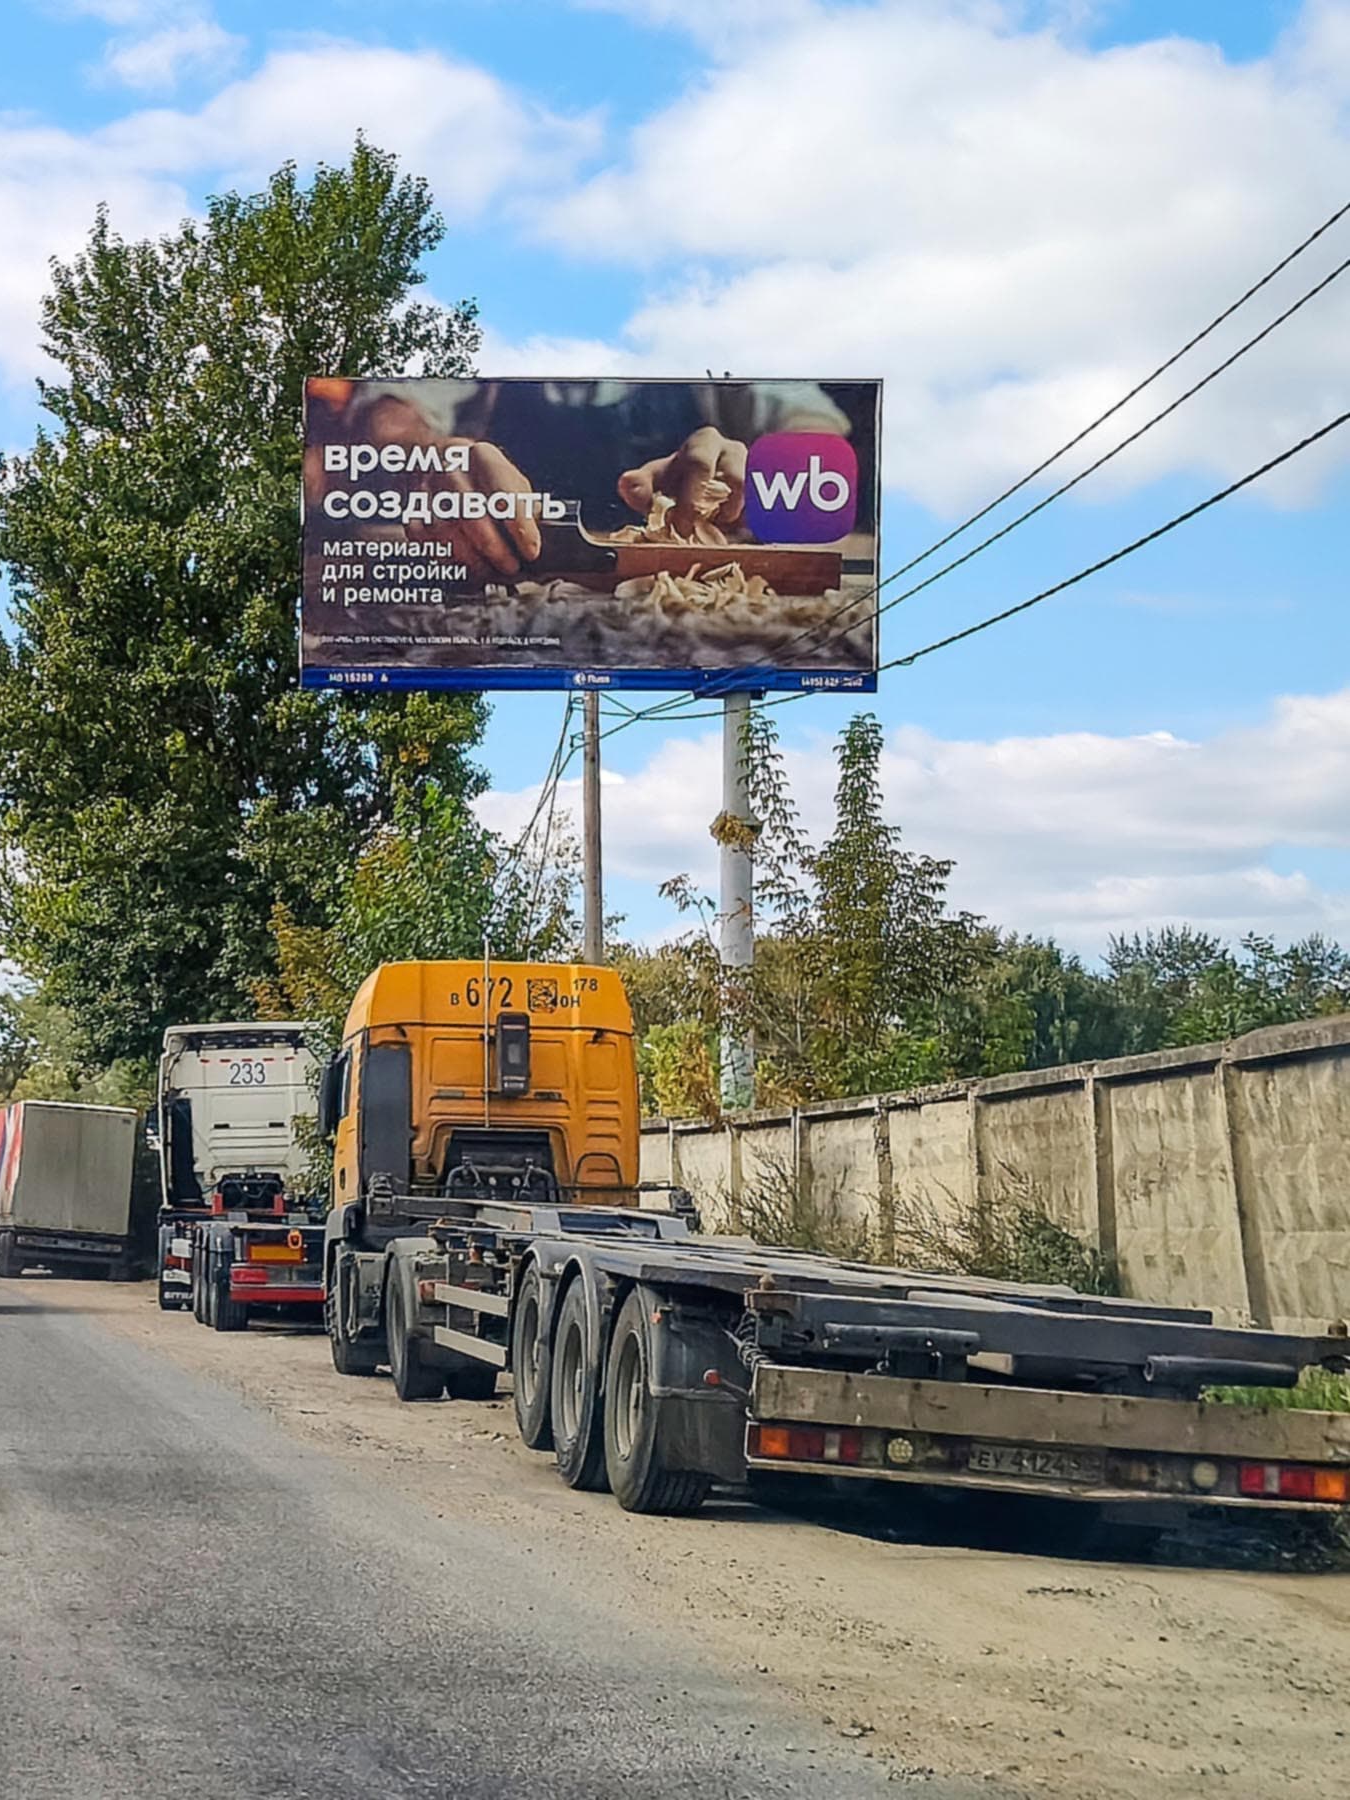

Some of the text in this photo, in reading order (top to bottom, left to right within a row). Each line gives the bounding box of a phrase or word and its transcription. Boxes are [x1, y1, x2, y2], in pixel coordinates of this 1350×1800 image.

[324, 444, 470, 481] время
[751, 455, 850, 512] wb
[323, 490, 567, 524] создавать
[323, 541, 452, 560] материалы
[322, 562, 467, 583] для стройки
[323, 587, 443, 606] и ремонта
[574, 978, 599, 991] 178
[230, 1062, 266, 1085] 233
